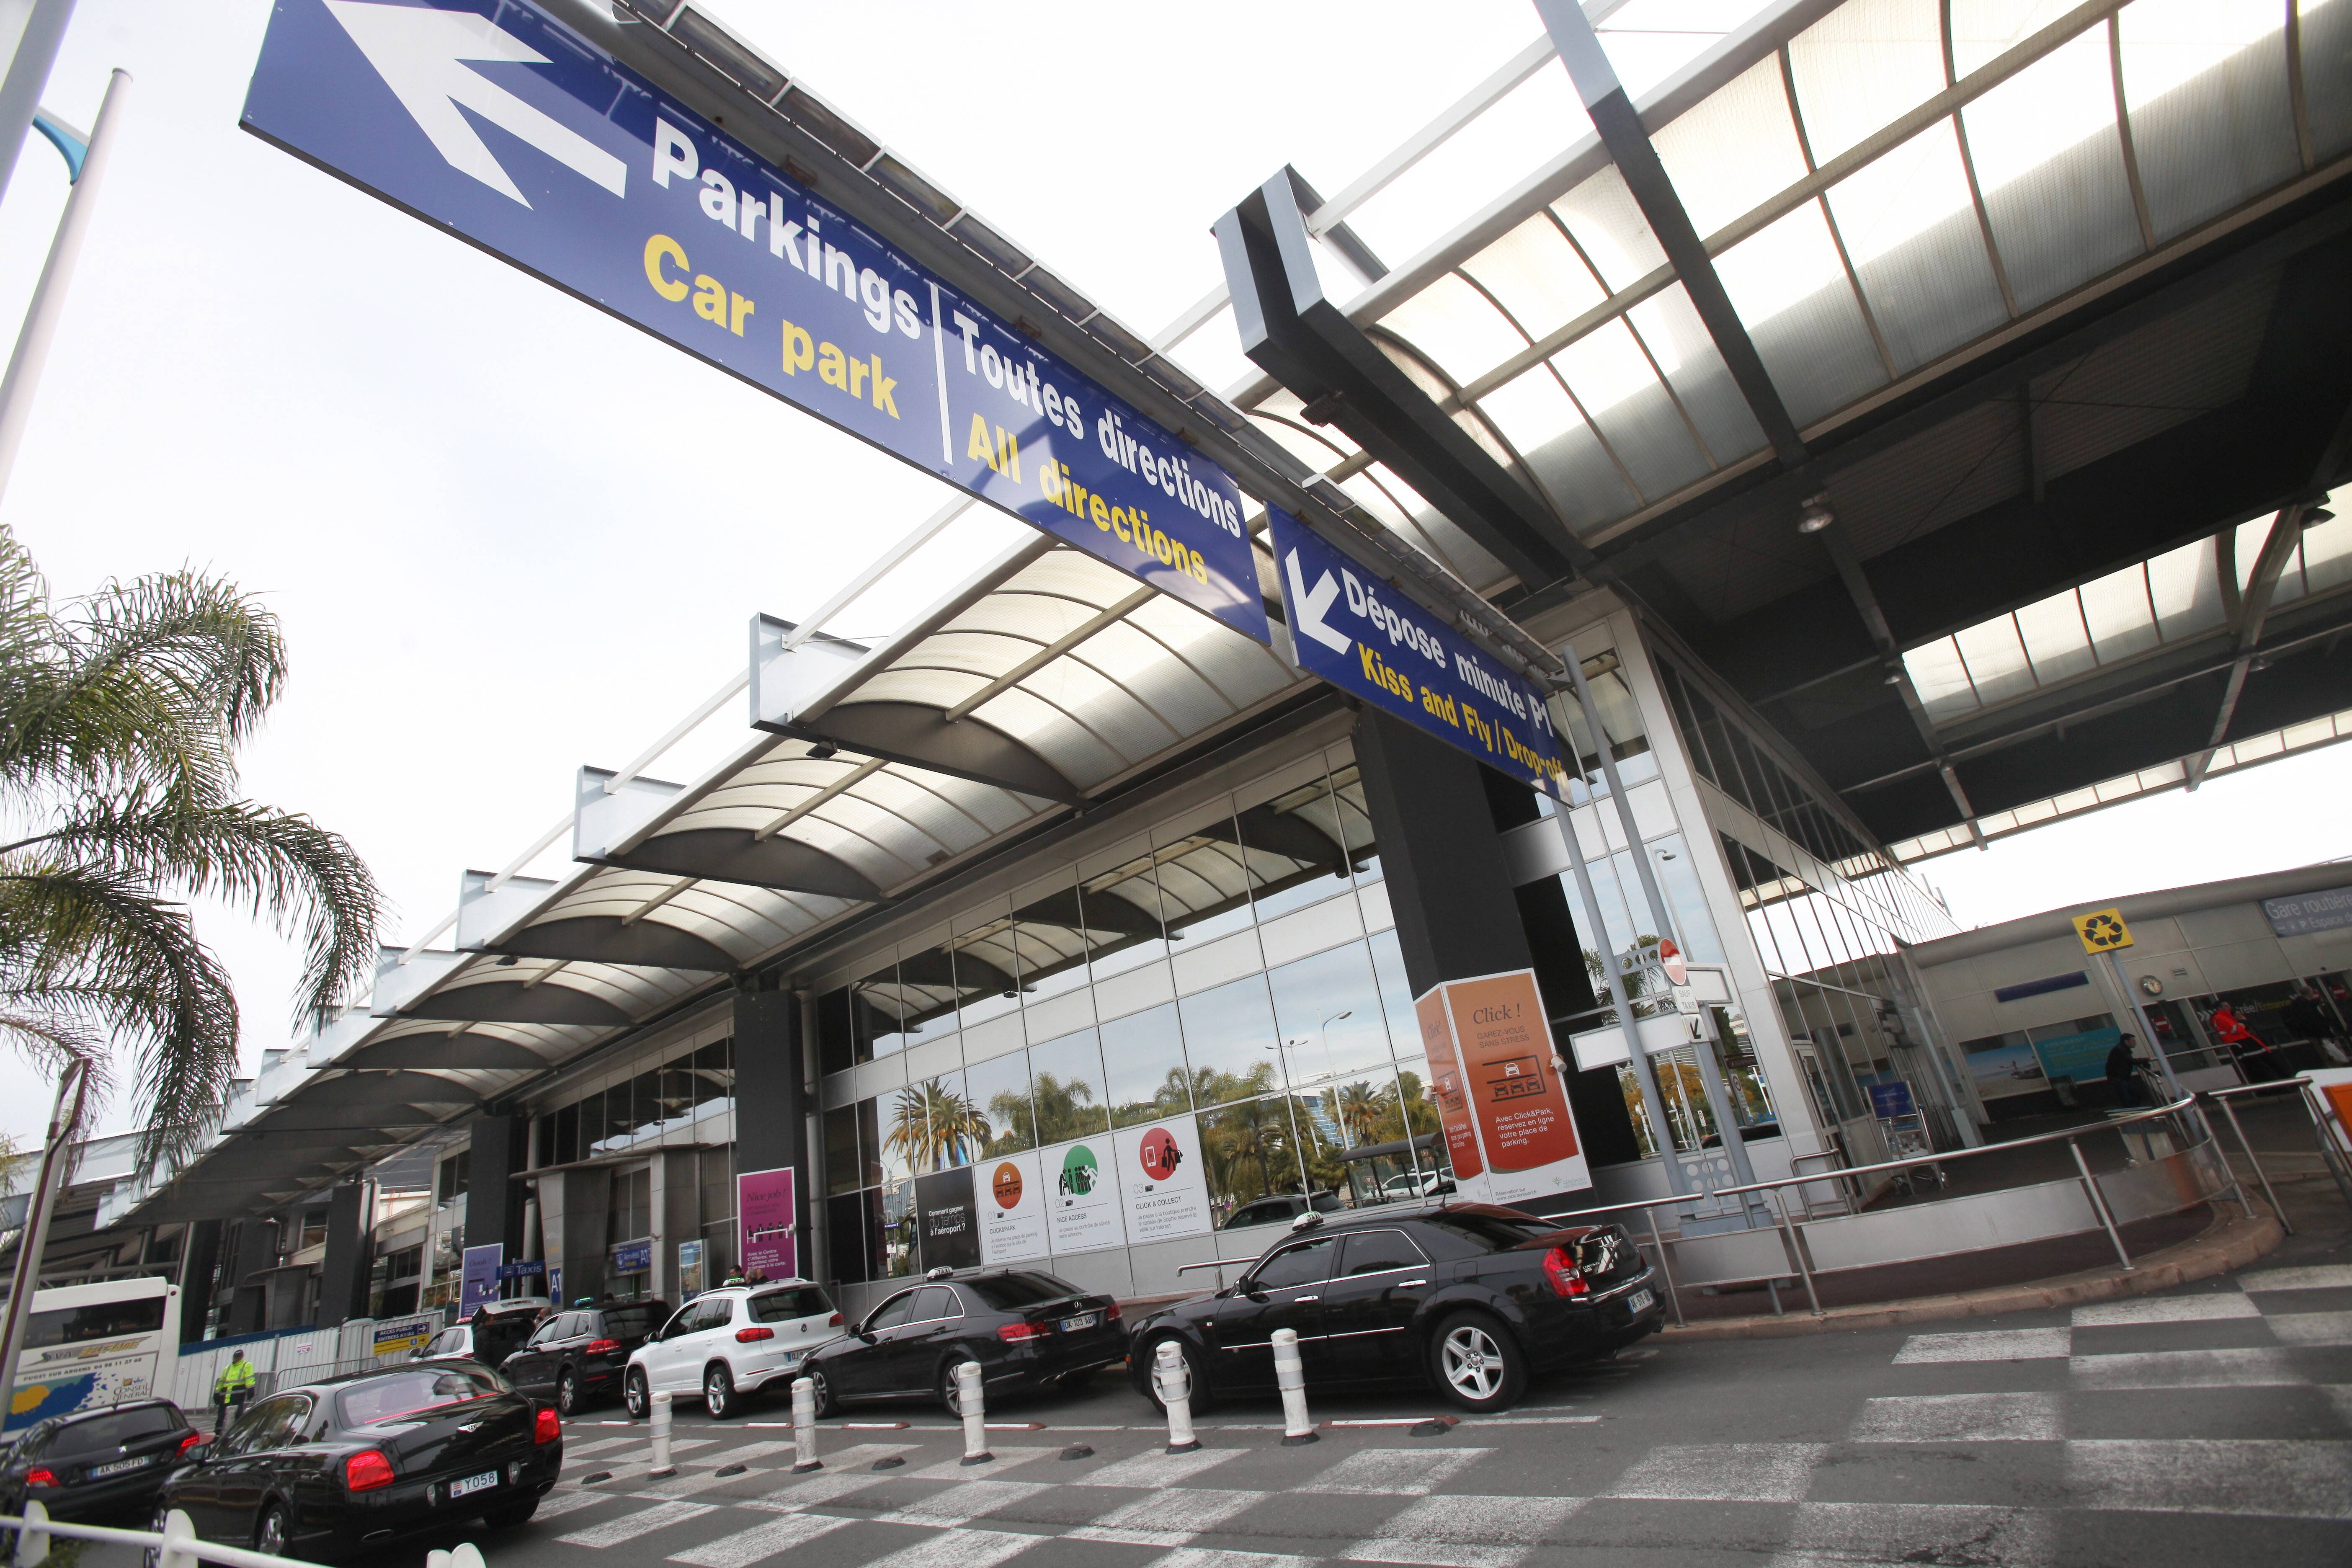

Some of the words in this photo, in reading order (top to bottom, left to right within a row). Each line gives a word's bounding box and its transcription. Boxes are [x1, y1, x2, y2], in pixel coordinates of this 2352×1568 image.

[652, 116, 921, 340] Parkings
[644, 234, 754, 338] Car
[782, 319, 900, 420] park
[953, 309, 1084, 441] Toutes
[1097, 408, 1241, 538] directions
[967, 413, 1021, 485] All
[1039, 457, 1208, 585] directions
[1341, 566, 1446, 669] Dépose
[1455, 651, 1527, 720] minute
[1527, 693, 1554, 738] P1
[1357, 642, 1413, 702] Kiss
[1420, 685, 1459, 728] and
[1461, 702, 1493, 753] Fly
[2265, 901, 2301, 919] Gare
[1473, 1004, 1512, 1024] Click
[1516, 1003, 1520, 1017] !
[1477, 1026, 1525, 1039] GAREZ-VOUS
[1479, 1039, 1500, 1048] SANS
[1501, 1034, 1530, 1045] STRESS
[1514, 1108, 1553, 1119] Click&Park,
[1497, 1121, 1527, 1131] réservez
[1537, 1116, 1555, 1125] ligne
[1519, 1127, 1537, 1137] place
[1501, 1138, 1529, 1149] parking.
[746, 1192, 766, 1202] Nice
[766, 1189, 781, 1202] job
[1133, 1184, 1144, 1194] 03
[1055, 1198, 1065, 1208] 02
[1157, 1196, 1181, 1206] COLLECT
[928, 1208, 949, 1217] Comment
[949, 1206, 964, 1214] gagner
[988, 1211, 995, 1220] 01
[1068, 1213, 1087, 1221] ACCESS
[929, 1215, 939, 1228] du
[941, 1213, 965, 1226] temps
[1163, 1215, 1177, 1224] Sophie
[935, 1224, 961, 1235] l'aéroport
[990, 1225, 1016, 1234] CLICK&PARK
[516, 1264, 542, 1274] Taxis
[551, 1273, 561, 1293] A1
[1064, 1316, 1092, 1329] DK-103-AB
[465, 1472, 495, 1490] Y058
